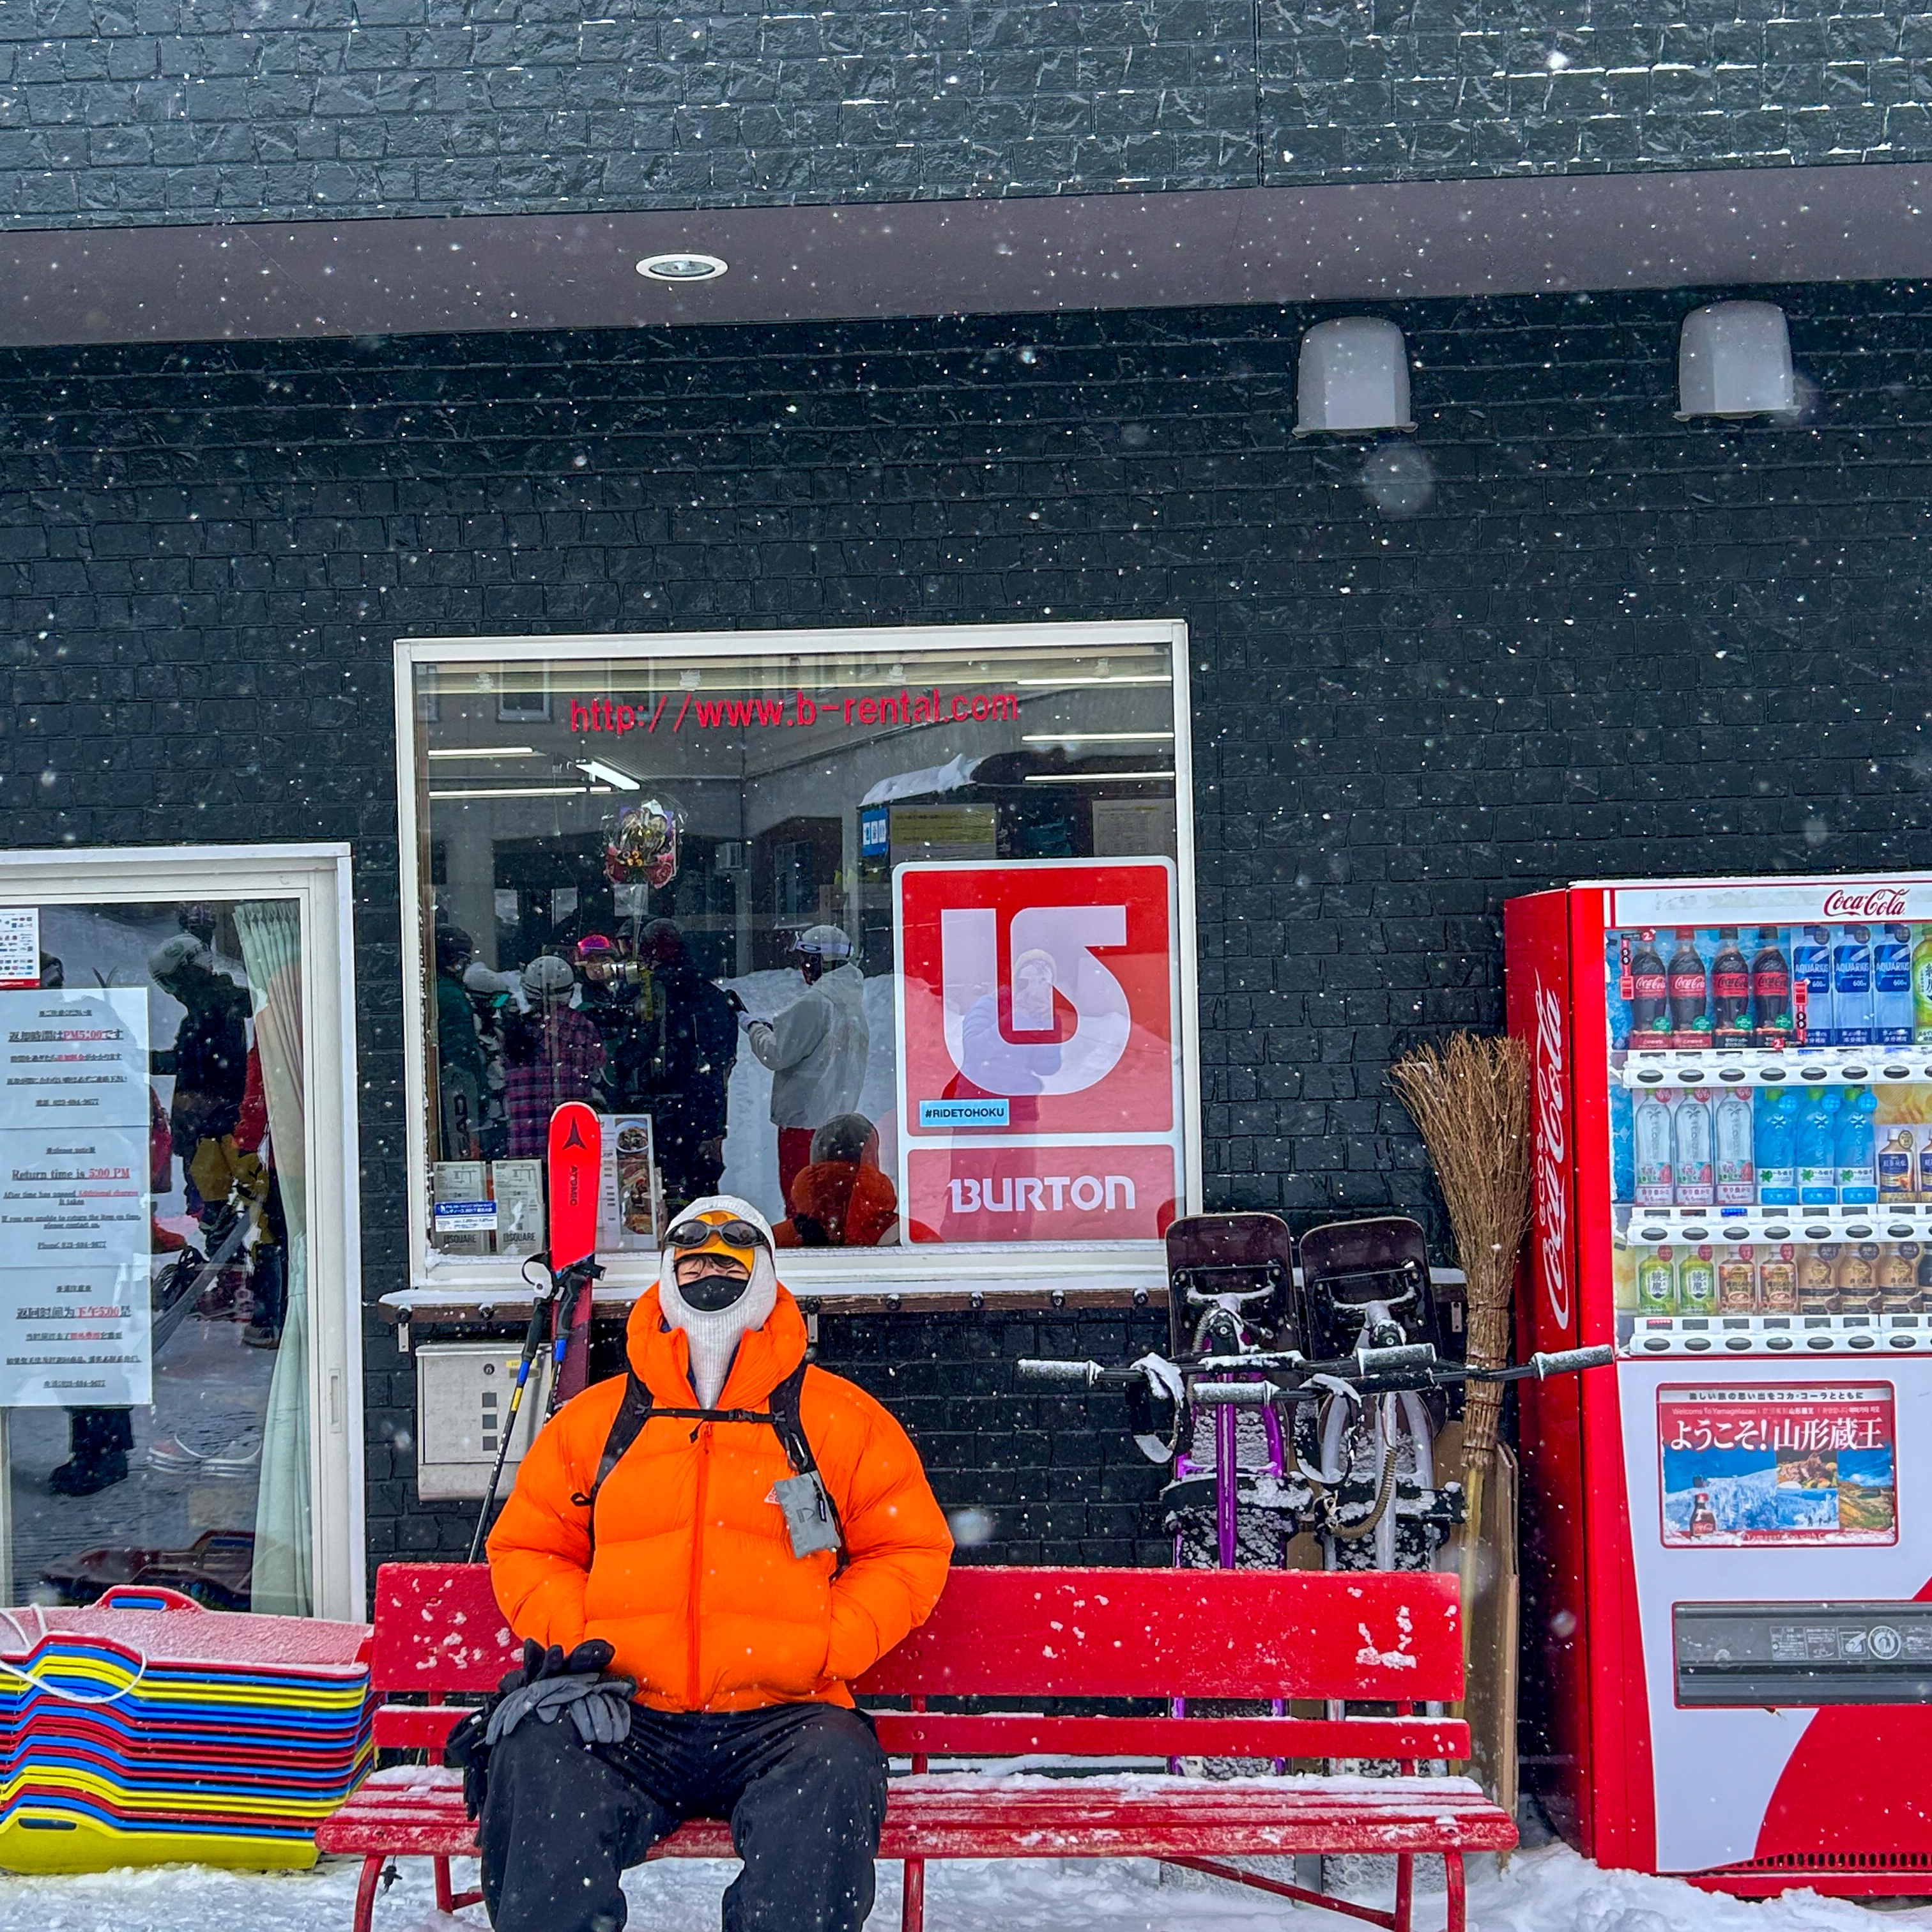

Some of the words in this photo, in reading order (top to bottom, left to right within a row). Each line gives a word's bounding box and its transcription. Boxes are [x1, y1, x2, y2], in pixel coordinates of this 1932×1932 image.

[571, 688, 1018, 734] http://www.b-rental.com
[1823, 888, 1910, 917] Coca-Cola
[1795, 963, 1828, 972] AQUARIUS
[1836, 962, 1869, 972] AQUARIUS
[1876, 962, 1910, 972] AQUARIUS
[924, 1107, 1005, 1119] #RIDETOHOKU
[1535, 967, 1569, 1330] Coca-Cola
[12, 1170, 47, 1181] Return
[51, 1169, 73, 1179] time
[77, 1169, 85, 1179] is
[569, 1165, 578, 1206] ATOMIC
[947, 1176, 1136, 1213] BURTON
